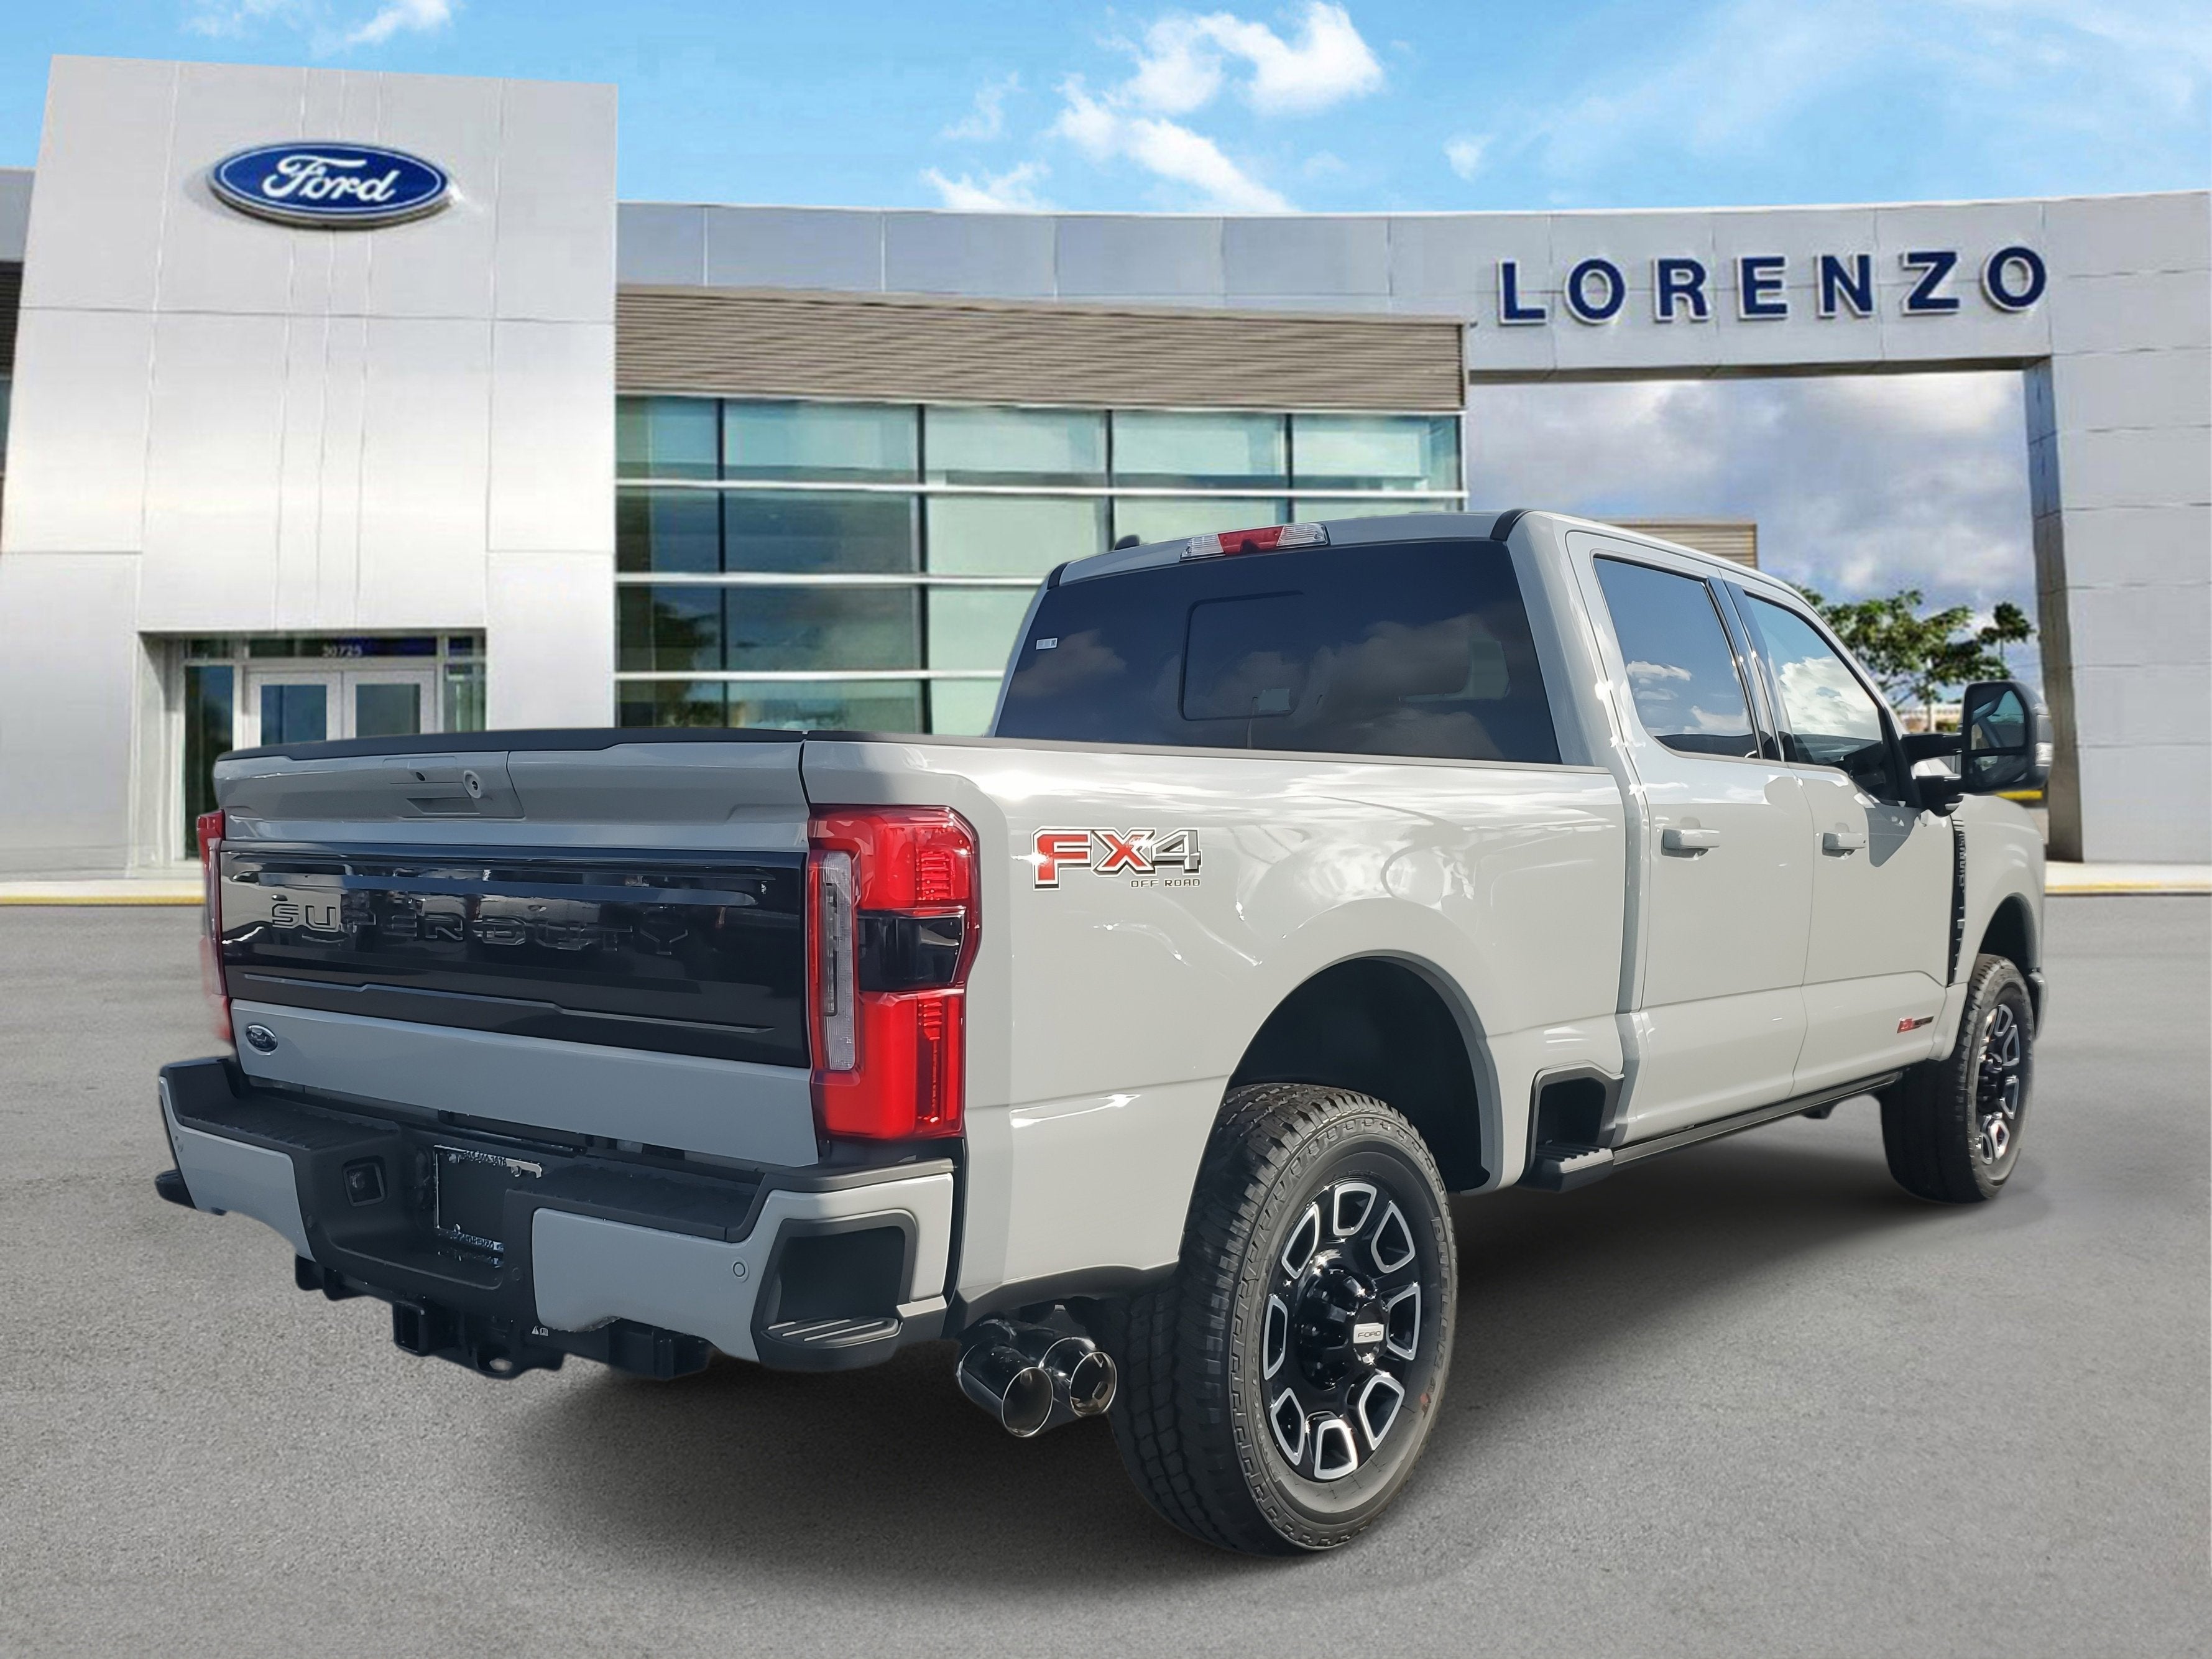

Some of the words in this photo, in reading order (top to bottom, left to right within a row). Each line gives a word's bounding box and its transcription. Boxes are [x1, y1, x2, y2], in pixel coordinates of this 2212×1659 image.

[262, 154, 400, 201] Ford
[1498, 246, 2048, 323] LORENZO
[1031, 826, 1202, 890] FX4
[1130, 879, 1159, 889] OFF
[1164, 878, 1201, 887] ROAD
